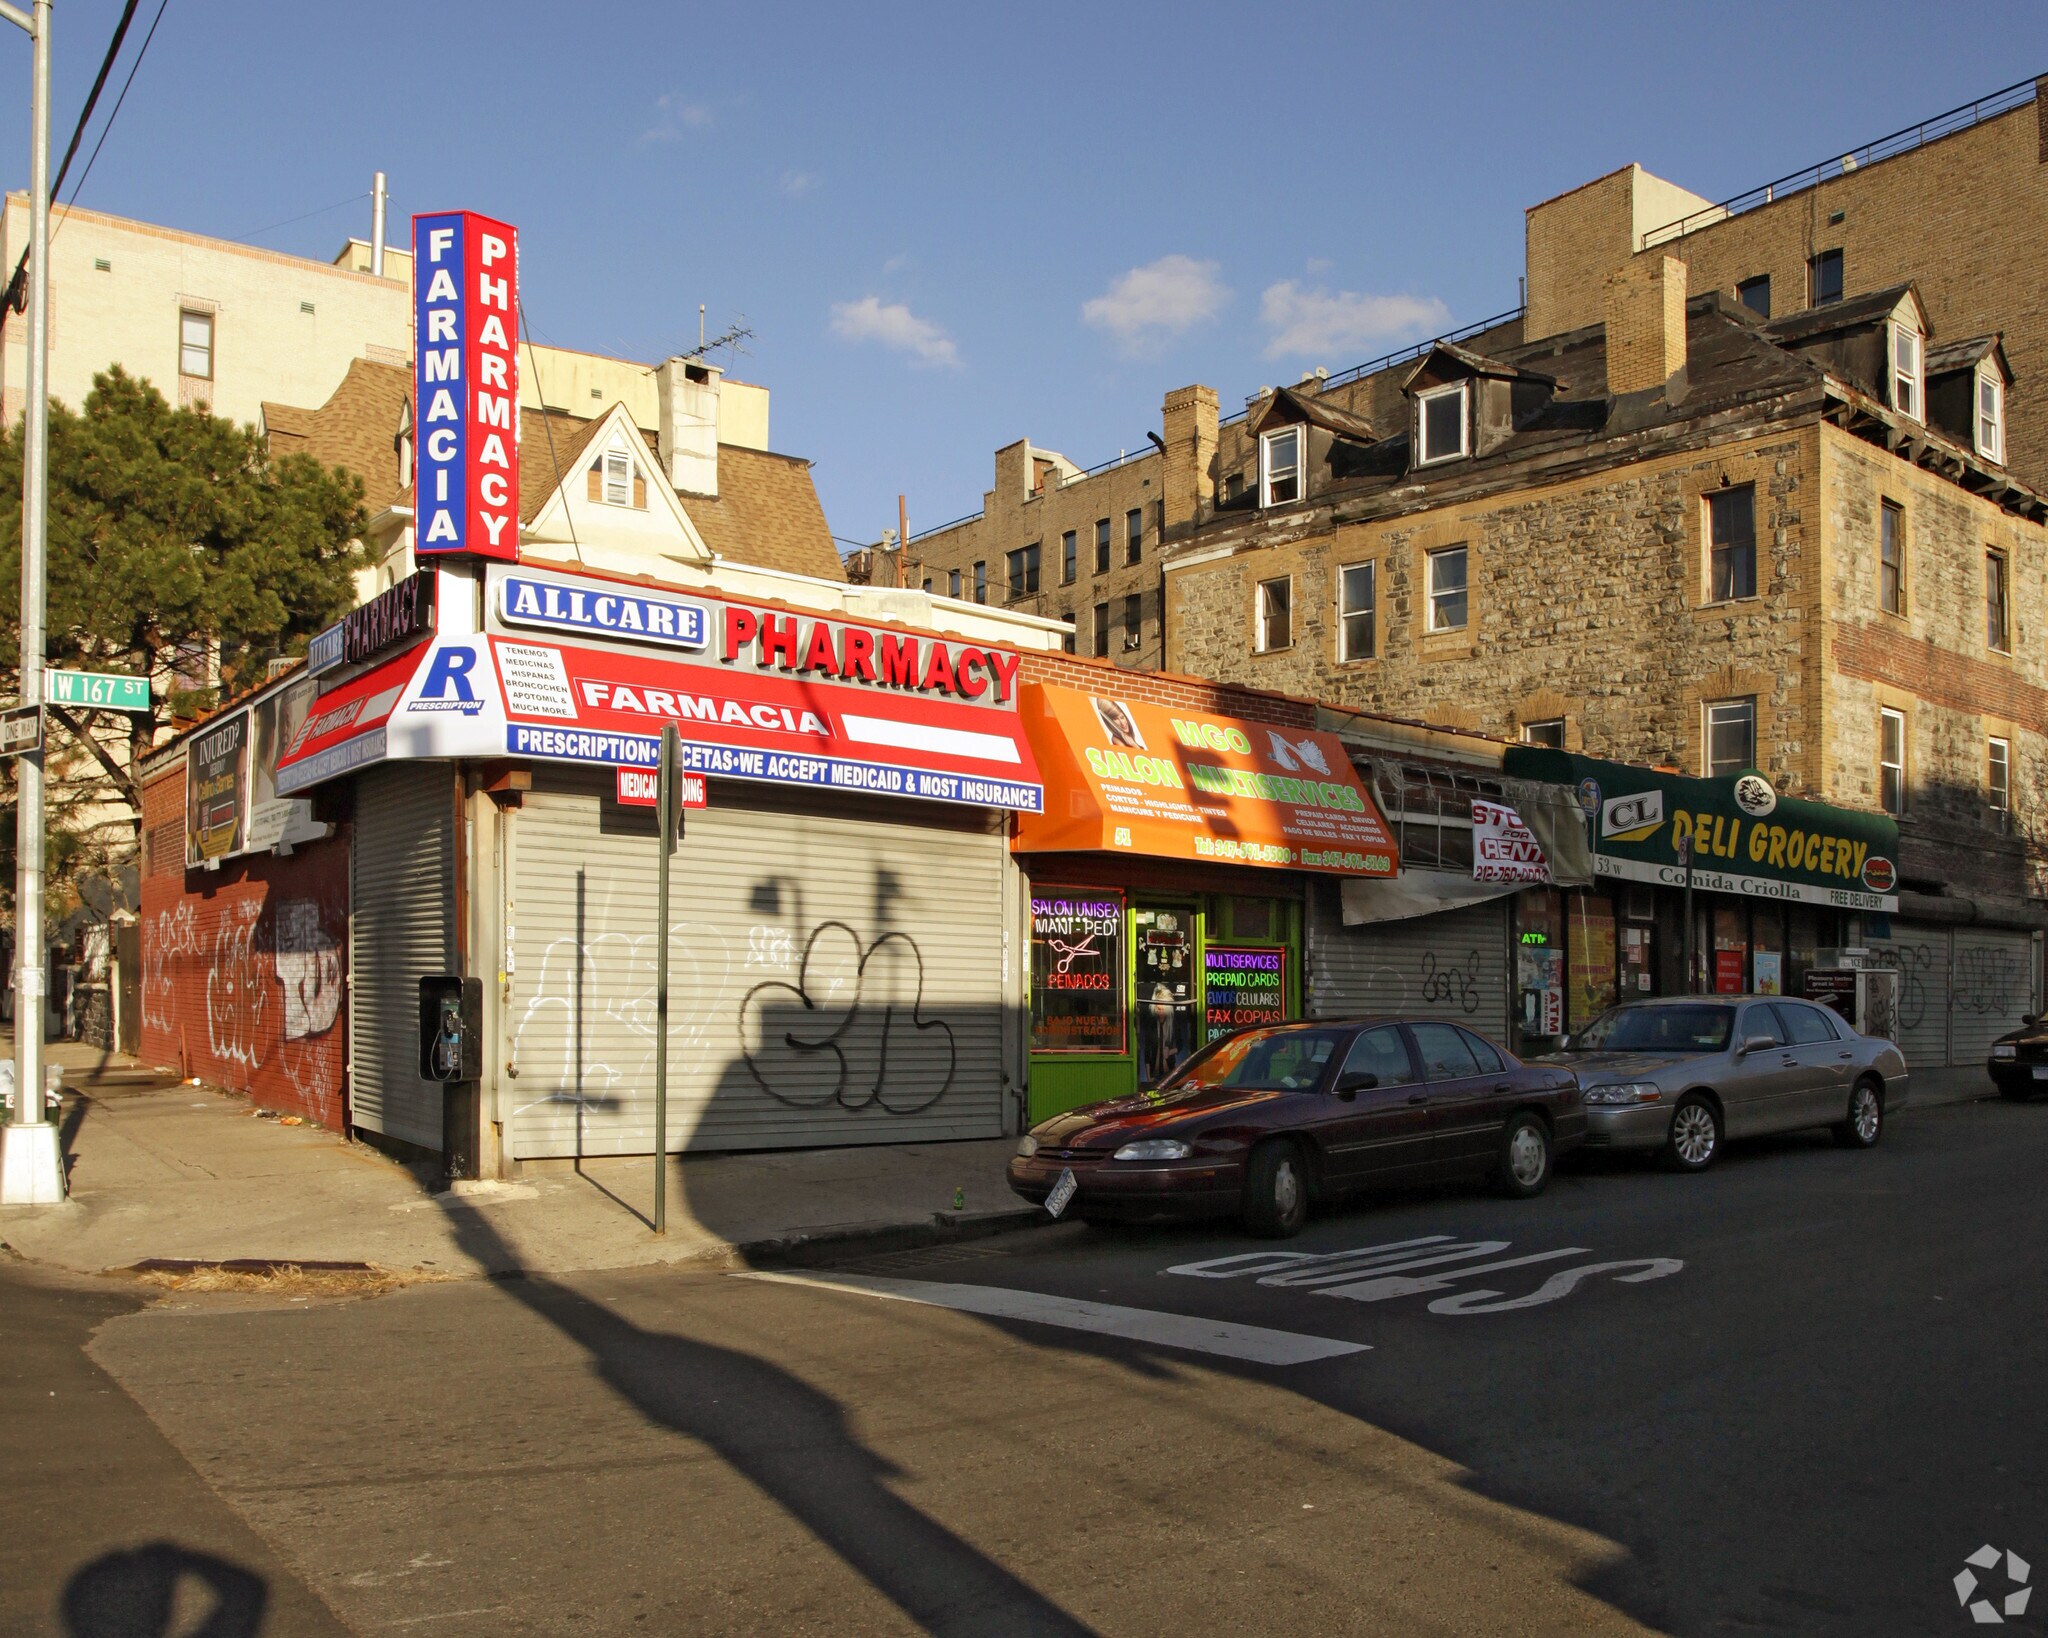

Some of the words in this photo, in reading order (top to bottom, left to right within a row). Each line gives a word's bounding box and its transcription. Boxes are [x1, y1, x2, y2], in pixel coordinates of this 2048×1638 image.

[425, 228, 460, 543] FARMACIA
[477, 233, 510, 546] PHARMACY
[344, 571, 420, 664] PHARMACY
[514, 583, 699, 639] ALLCARE
[309, 630, 343, 669] ALLCARE
[505, 647, 549, 658] TENEMOS
[725, 606, 1021, 702] PHARMACY
[505, 658, 555, 669] MEDICINAS
[511, 669, 555, 681] HISPANAS
[58, 675, 74, 700] W
[82, 677, 116, 703] 167
[124, 681, 143, 695] ST
[505, 679, 568, 693] BRONCOCHEN
[409, 701, 482, 711] PRESCRIPTION
[512, 702, 540, 712] MUCH
[513, 691, 558, 704] APOTOMIL
[581, 681, 829, 736] FARMACIA
[308, 697, 364, 741] FARMACIA
[5, 721, 19, 740] ONE
[21, 720, 36, 737] WAY
[1170, 718, 1251, 755] MGO
[199, 722, 240, 766] INJURED?
[1085, 747, 1184, 789] SALON
[767, 760, 828, 781] ACCEPT
[831, 765, 901, 792] MEDICAID
[905, 774, 916, 793] &
[920, 775, 957, 798] MOST
[961, 782, 1037, 809] INSURANCE
[1100, 783, 1143, 797] PEINADOS
[1187, 763, 1365, 813] MULTISERVICES
[1106, 794, 1140, 806] CORTES
[1144, 799, 1194, 813] HIGHLIGHTS
[1199, 806, 1227, 817] TINTES
[1110, 804, 1155, 817] MANICURE
[1156, 808, 1162, 817] Y
[1163, 811, 1203, 823] PEDICURE
[1608, 797, 1658, 829] CL
[1295, 809, 1325, 819] PREPAID
[1325, 813, 1348, 822] CARDS
[1351, 816, 1377, 825] ENVIOS
[1296, 818, 1336, 829] CELULARES
[1340, 823, 1382, 834] ACCESORIOS
[1114, 827, 1132, 846] 51
[1282, 826, 1303, 835] PAGO
[1303, 828, 1314, 836] DE
[1314, 830, 1338, 839] BILLES
[1341, 833, 1356, 841] FAX
[1361, 835, 1387, 844] COPIAS
[1501, 830, 1530, 840] FOR
[1671, 809, 1741, 859] DELI
[1749, 822, 1868, 880] GROCERY
[1194, 836, 1215, 855] Tel:
[1214, 839, 1291, 865] 347-591-5500
[1301, 848, 1322, 866] Fax:
[1322, 850, 1391, 872] 347-591-5163
[1597, 857, 1610, 874] 53
[1659, 867, 1734, 891] Comida
[1740, 878, 1801, 899] Criolla
[1031, 899, 1073, 917] SALON
[1075, 902, 1120, 918] UNISEX
[1830, 890, 1848, 905] FREE
[1850, 893, 1884, 909] DELIVERY
[1035, 918, 1072, 935] MANI
[1084, 920, 1118, 936] PEDI
[1205, 953, 1279, 970] MULTISERVICES
[1047, 973, 1110, 990] PEINADOS
[1206, 972, 1246, 987] PREPAID
[1247, 973, 1279, 987] CARDS
[1236, 992, 1280, 1006] CELULARES
[1207, 1009, 1231, 1024] FAX
[1234, 1009, 1280, 1024] COPIAS
[1549, 991, 1560, 1033] ATM
